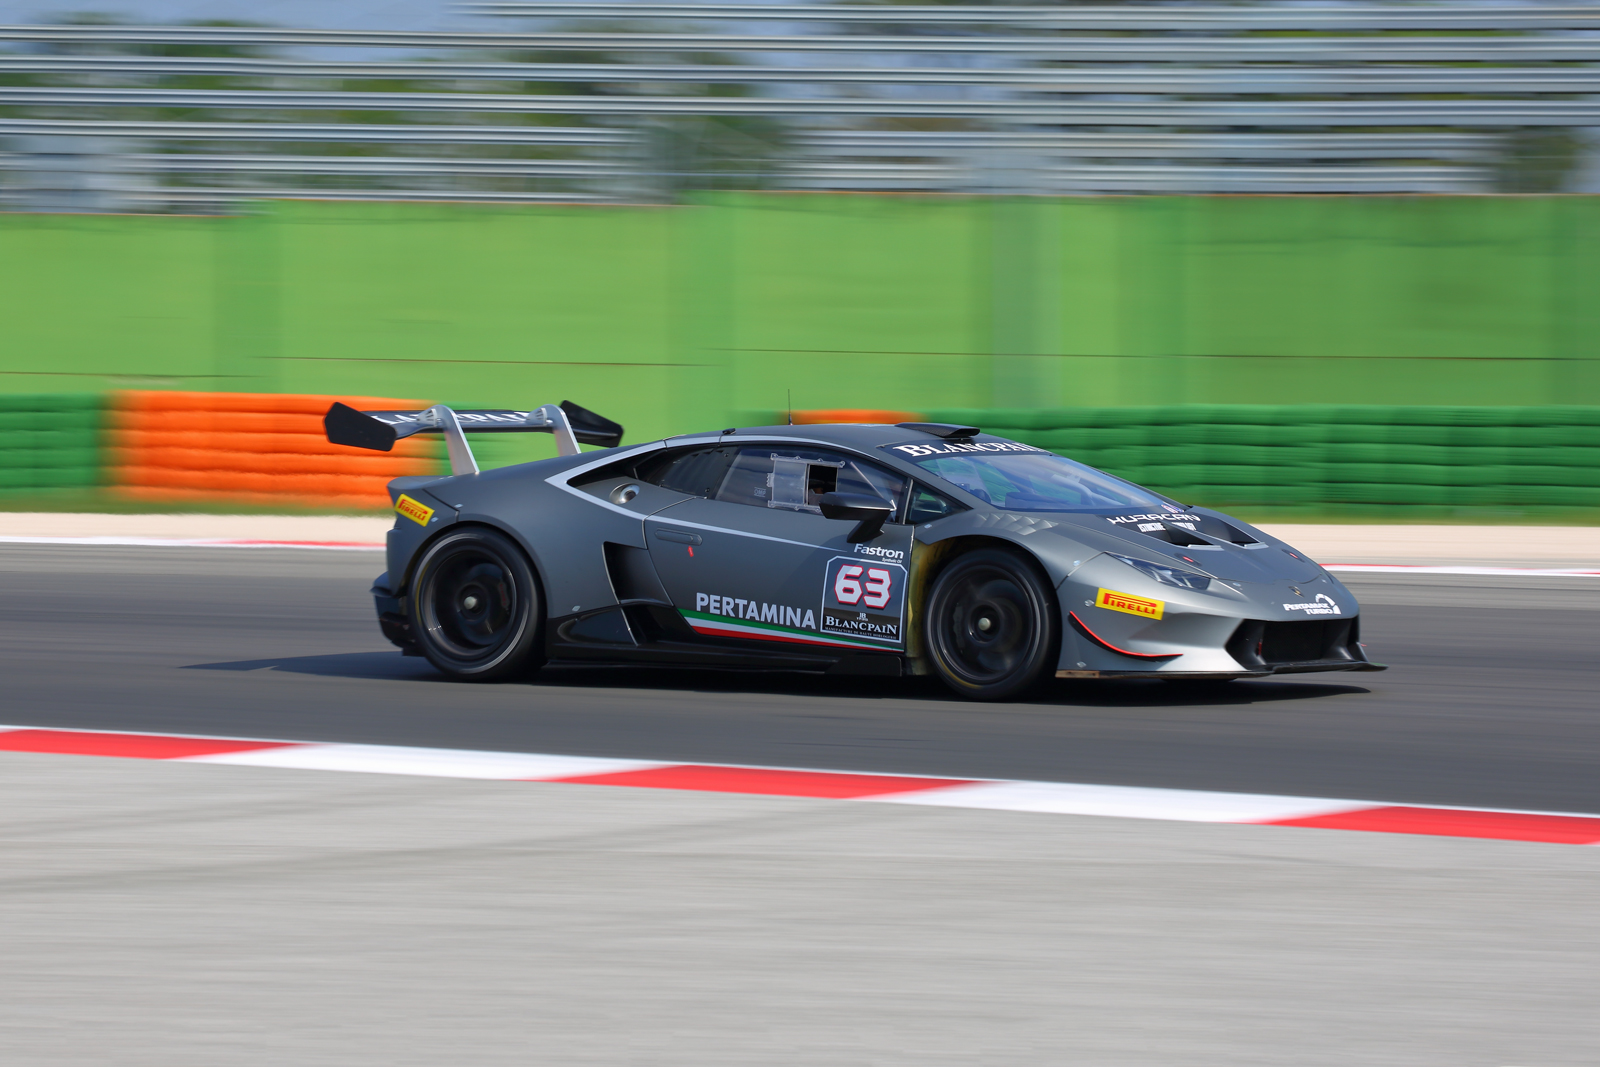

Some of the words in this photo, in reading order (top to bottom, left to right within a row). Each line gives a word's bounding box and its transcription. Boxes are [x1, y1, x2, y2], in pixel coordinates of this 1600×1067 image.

[398, 499, 428, 521] PIRELLI
[853, 543, 904, 559] Fastron
[834, 564, 892, 609] 63
[696, 592, 816, 629] PERTAMINA
[1103, 592, 1157, 614] PIRELLI
[1282, 603, 1331, 611] PERTAMAX
[825, 615, 897, 635] BLANCPAIN
